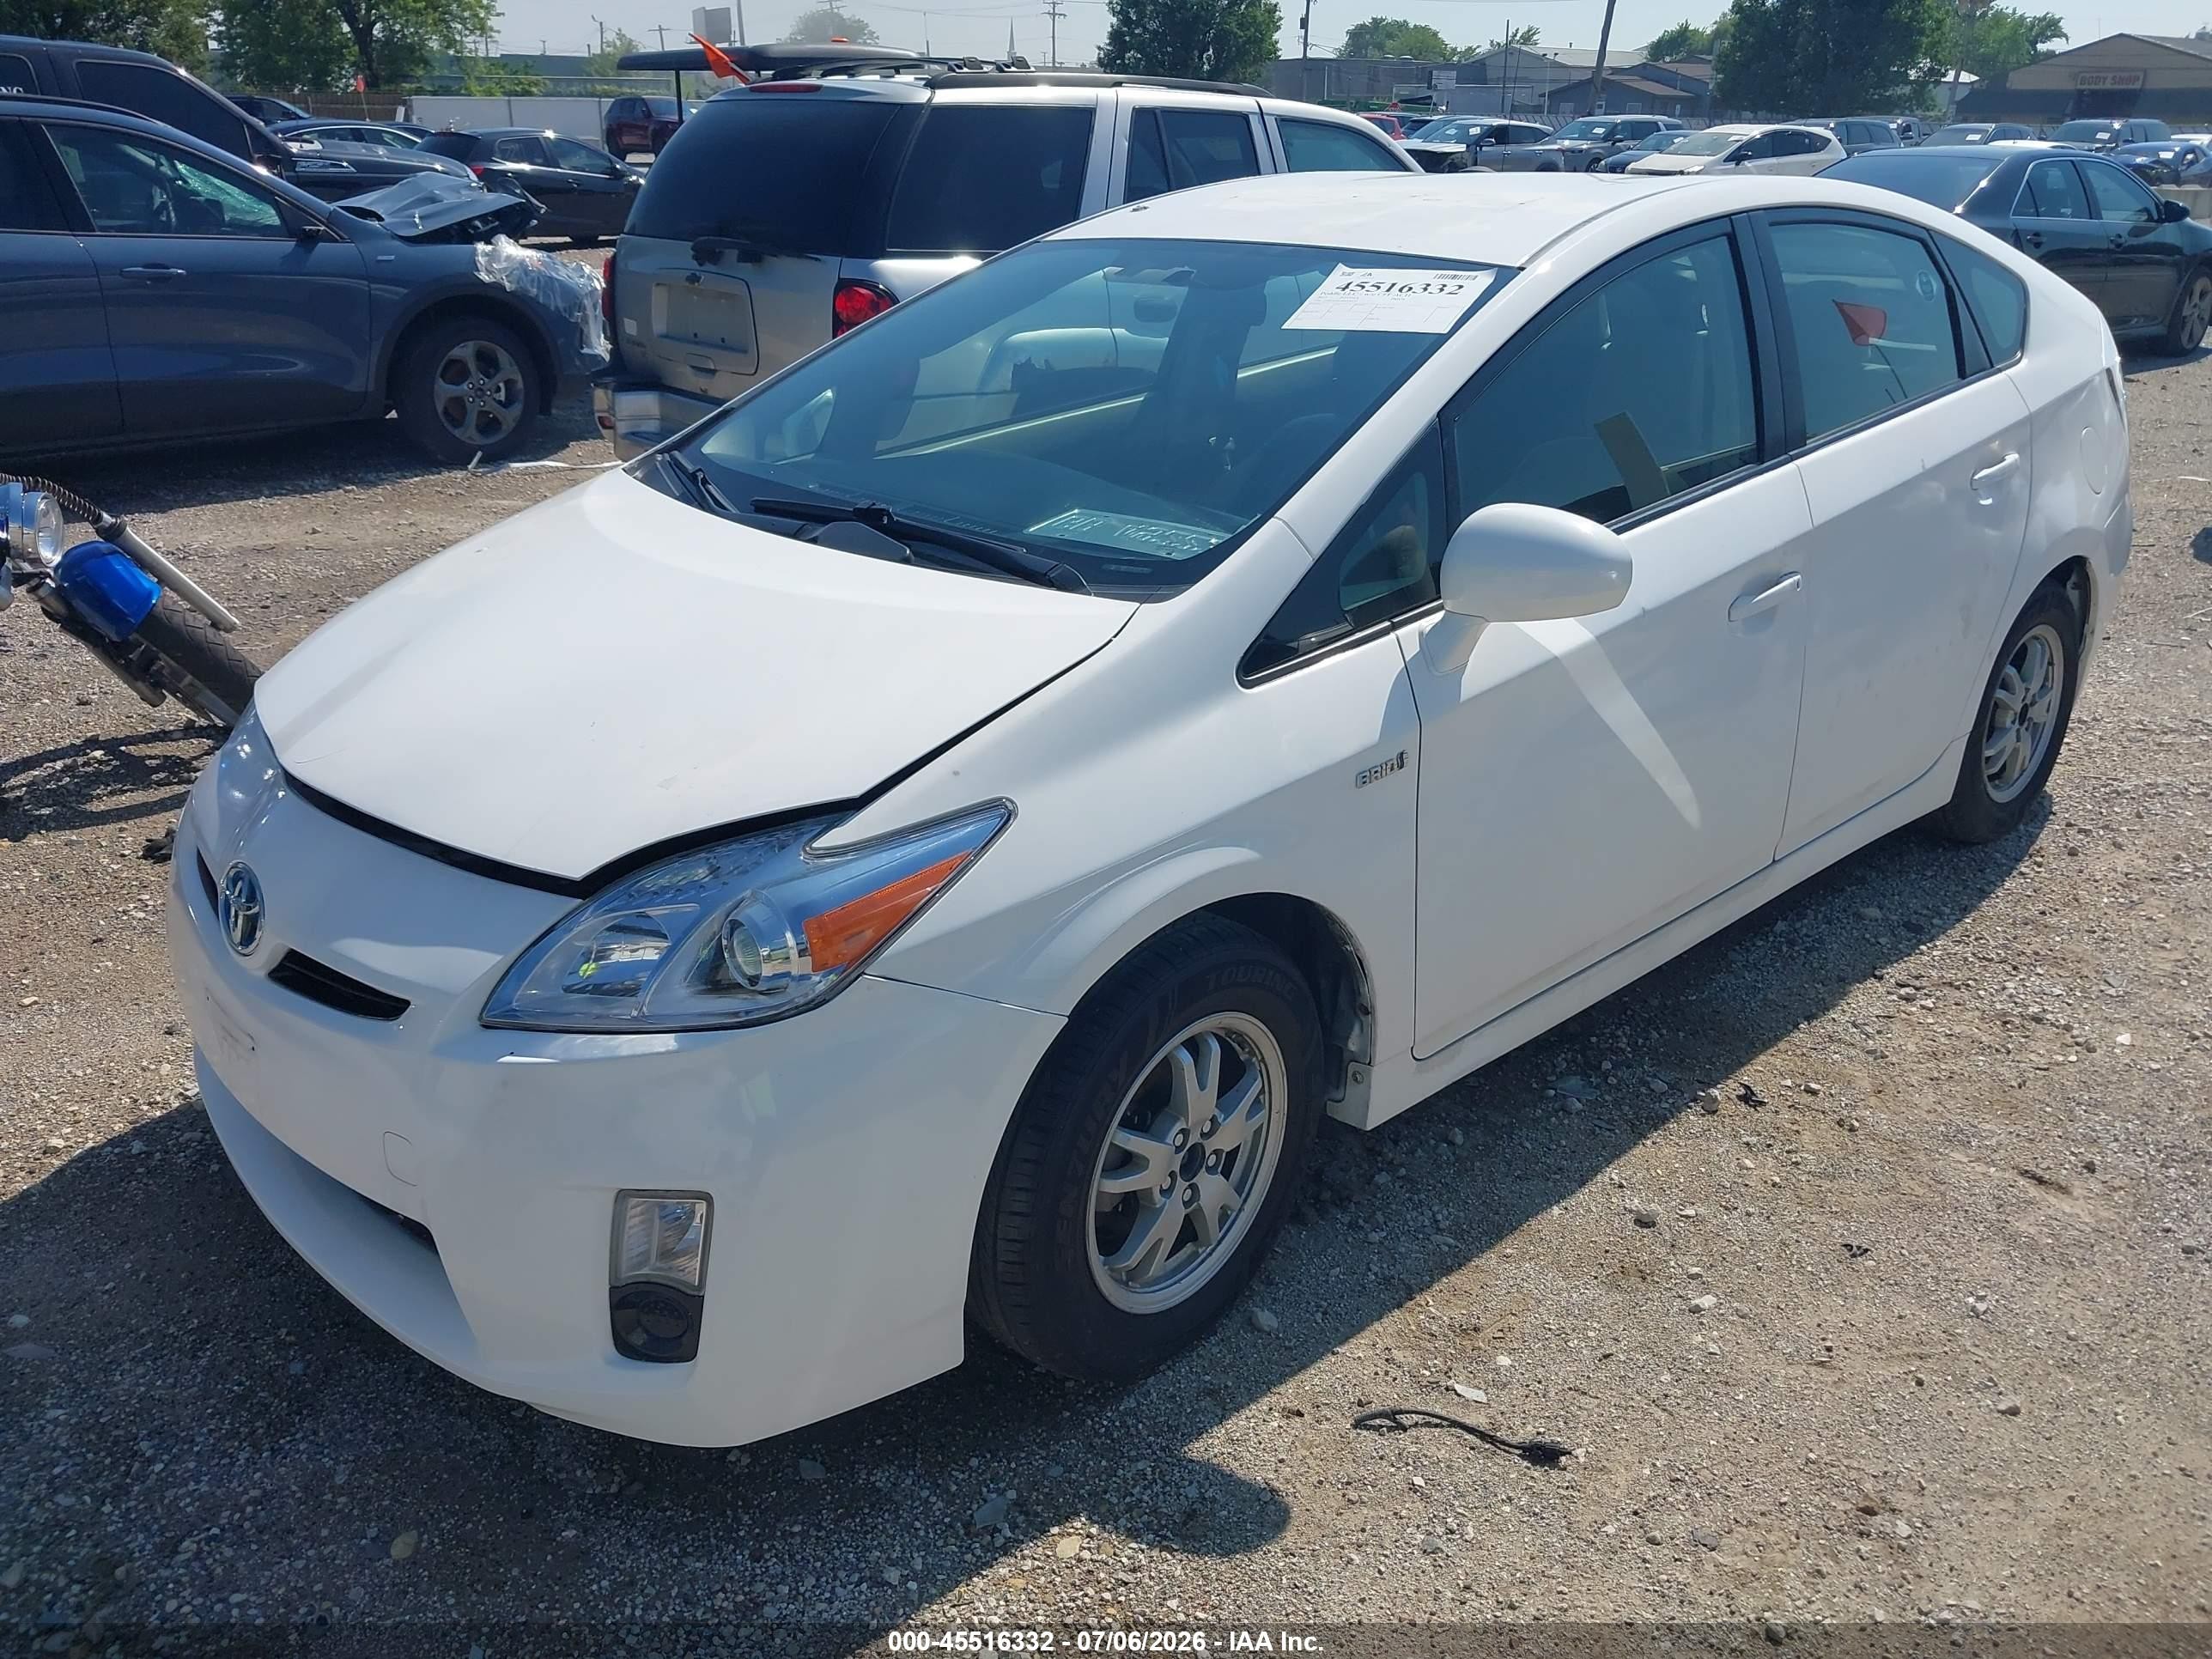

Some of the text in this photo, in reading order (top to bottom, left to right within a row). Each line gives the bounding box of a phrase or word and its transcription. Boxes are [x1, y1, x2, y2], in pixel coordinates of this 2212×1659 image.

[2080, 75, 2140, 86] BODY SHOP
[1334, 281, 1465, 295] 45516332
